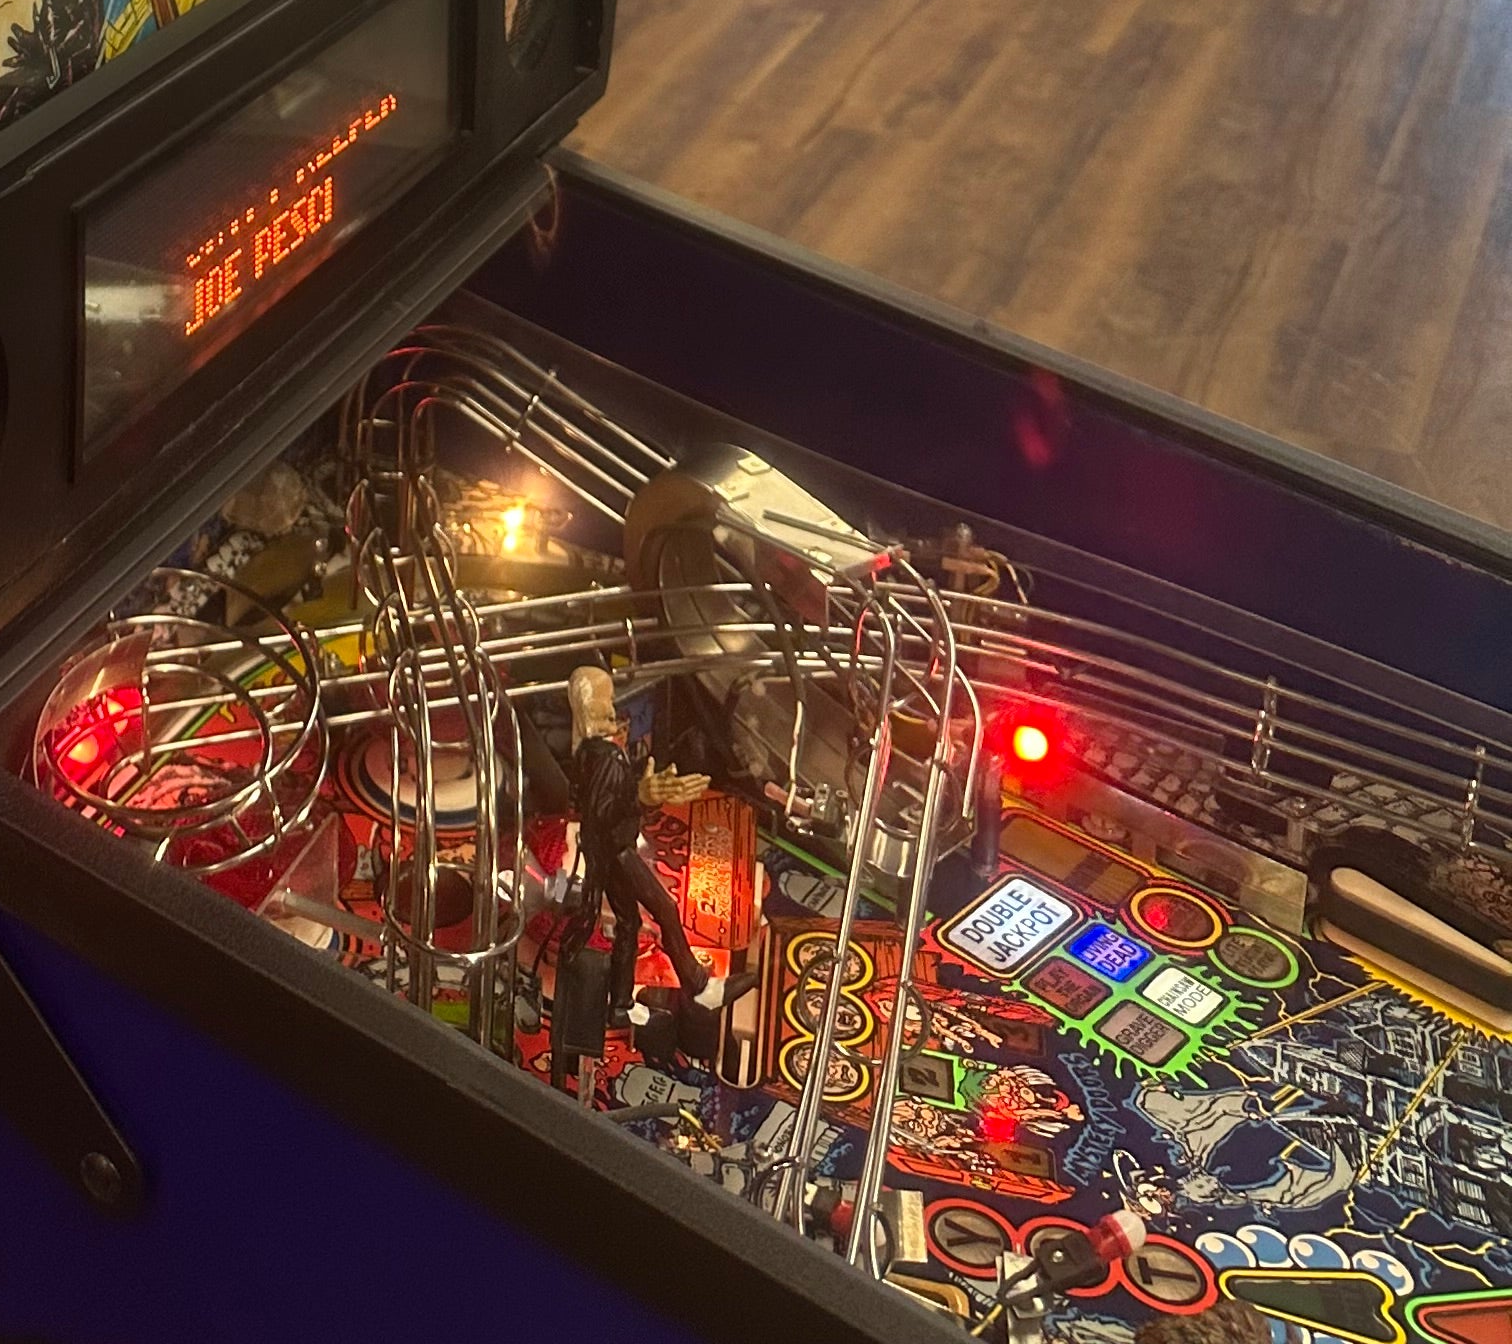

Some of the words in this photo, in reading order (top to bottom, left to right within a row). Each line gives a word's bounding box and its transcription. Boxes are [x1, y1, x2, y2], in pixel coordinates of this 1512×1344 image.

[185, 248, 243, 336] JOE
[253, 176, 333, 280] PESCI
[960, 889, 1033, 944] DOUBLE
[986, 902, 1061, 963] JACKPOT
[1083, 932, 1120, 962] LIVING
[1097, 943, 1138, 973] DEAD
[1172, 984, 1212, 1018] MODE
[1115, 1010, 1156, 1045] GRAVE
[1129, 1024, 1169, 1056] DIGGER
